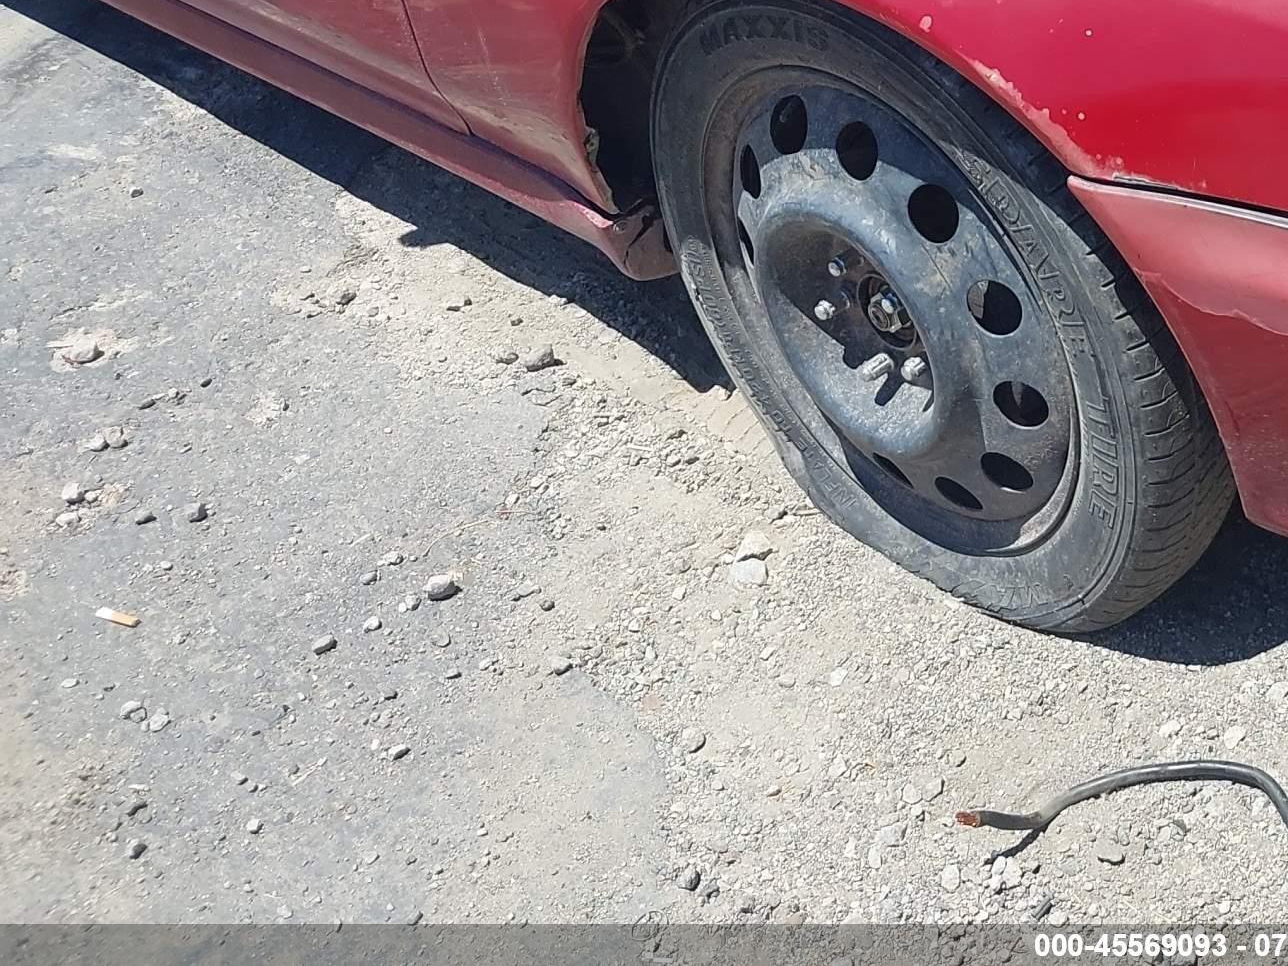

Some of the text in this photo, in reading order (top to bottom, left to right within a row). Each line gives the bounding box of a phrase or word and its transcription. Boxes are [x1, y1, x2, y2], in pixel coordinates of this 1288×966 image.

[699, 14, 830, 56] MAXXIS
[796, 437, 858, 511] INFLATE
[1086, 395, 1121, 530] TIRE
